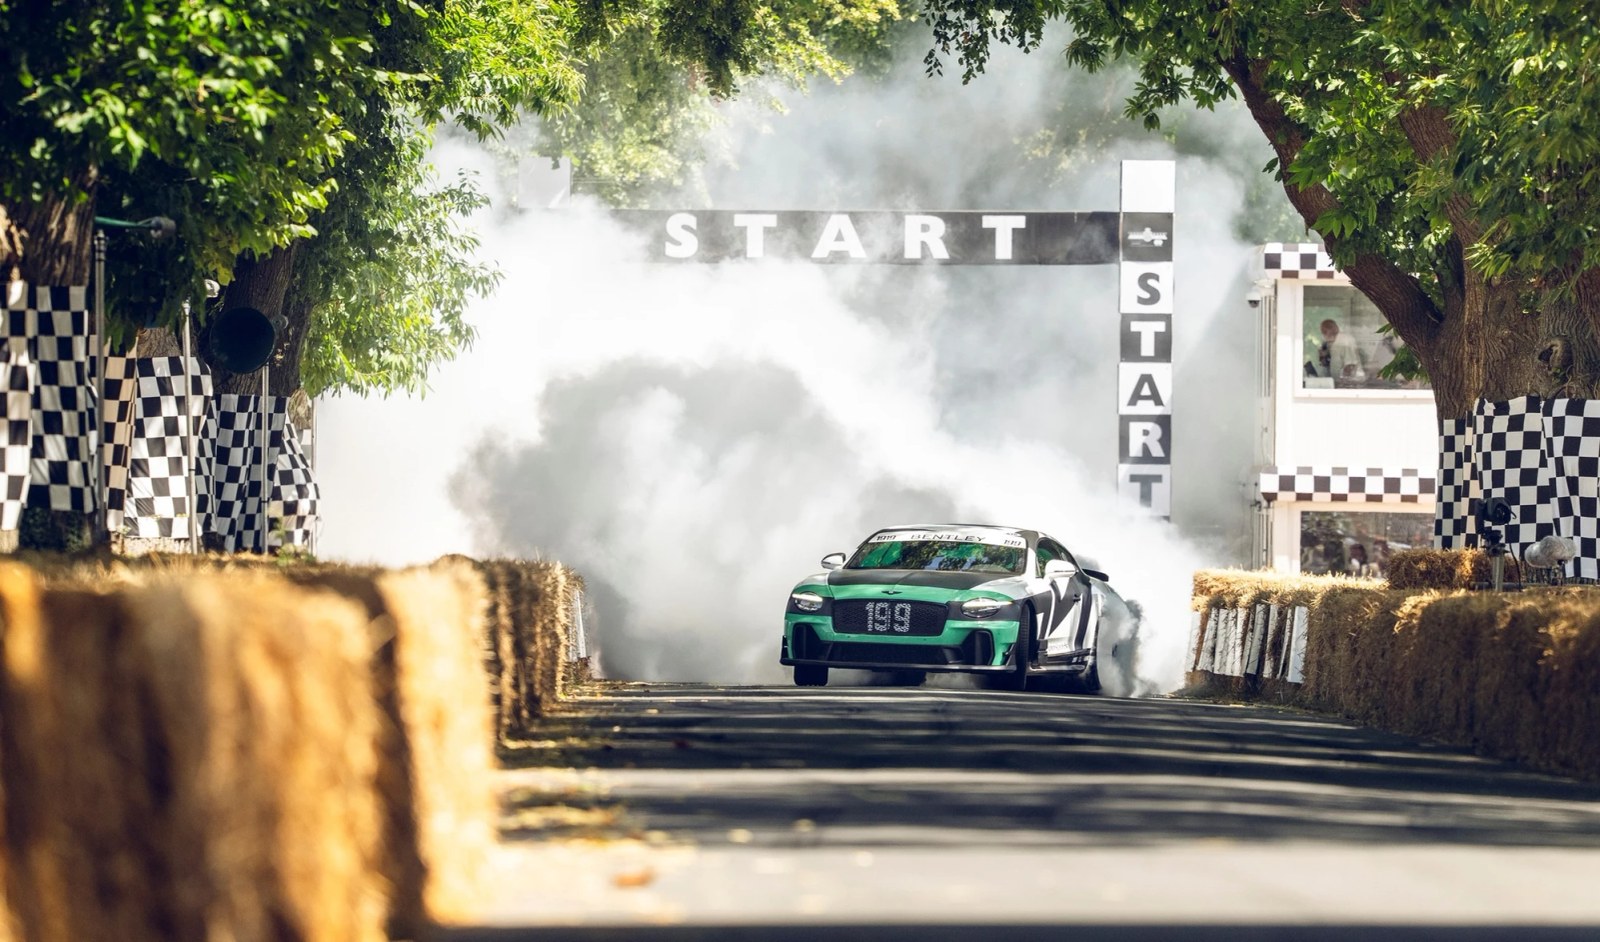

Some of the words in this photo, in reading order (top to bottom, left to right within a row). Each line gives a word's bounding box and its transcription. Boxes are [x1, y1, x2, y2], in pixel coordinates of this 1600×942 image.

[664, 212, 1027, 260] START
[1126, 272, 1166, 508] START
[911, 534, 987, 542] BENTLEY
[865, 602, 911, 632] 199
